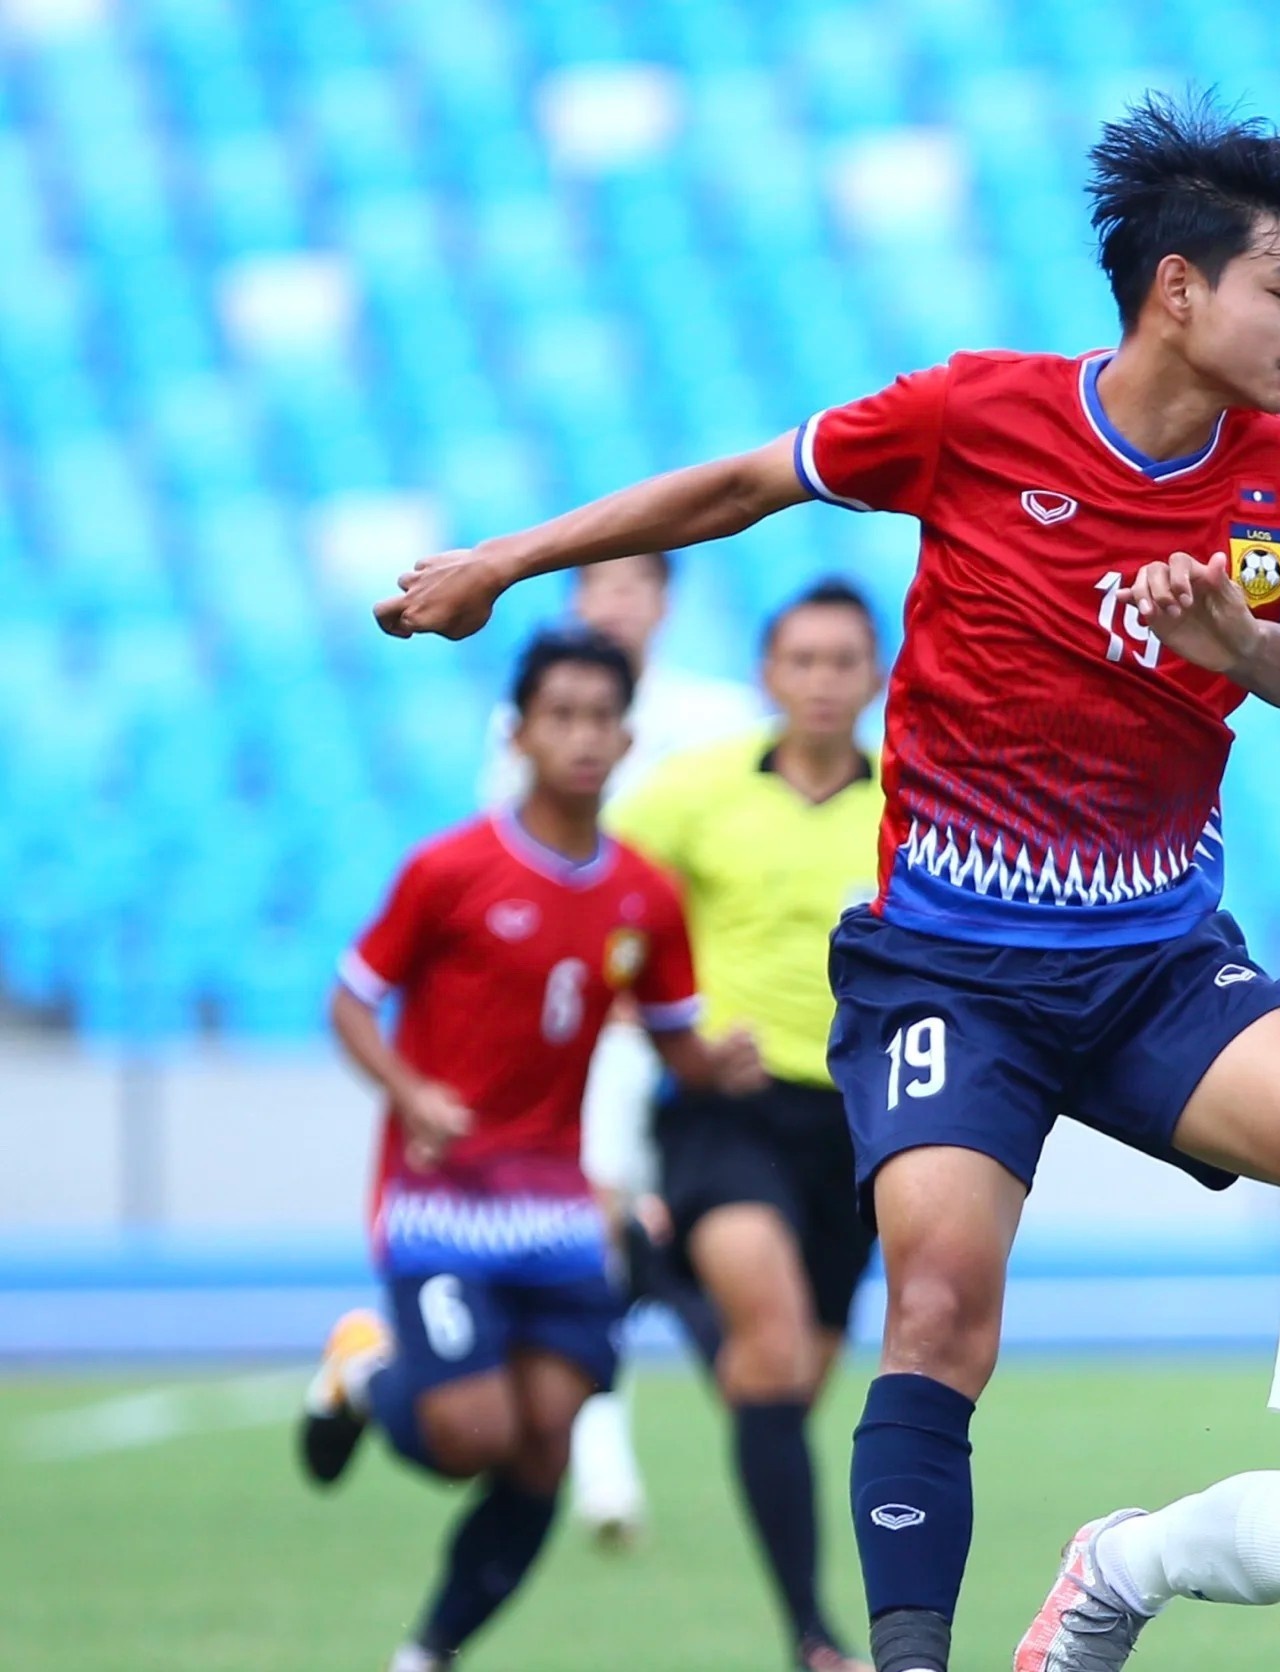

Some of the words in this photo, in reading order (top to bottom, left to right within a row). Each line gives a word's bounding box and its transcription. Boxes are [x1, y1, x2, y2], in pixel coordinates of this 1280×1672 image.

[1246, 529, 1272, 542] LAOS
[541, 957, 589, 1044] 6
[885, 1017, 945, 1111] 19
[419, 1273, 474, 1360] 6
